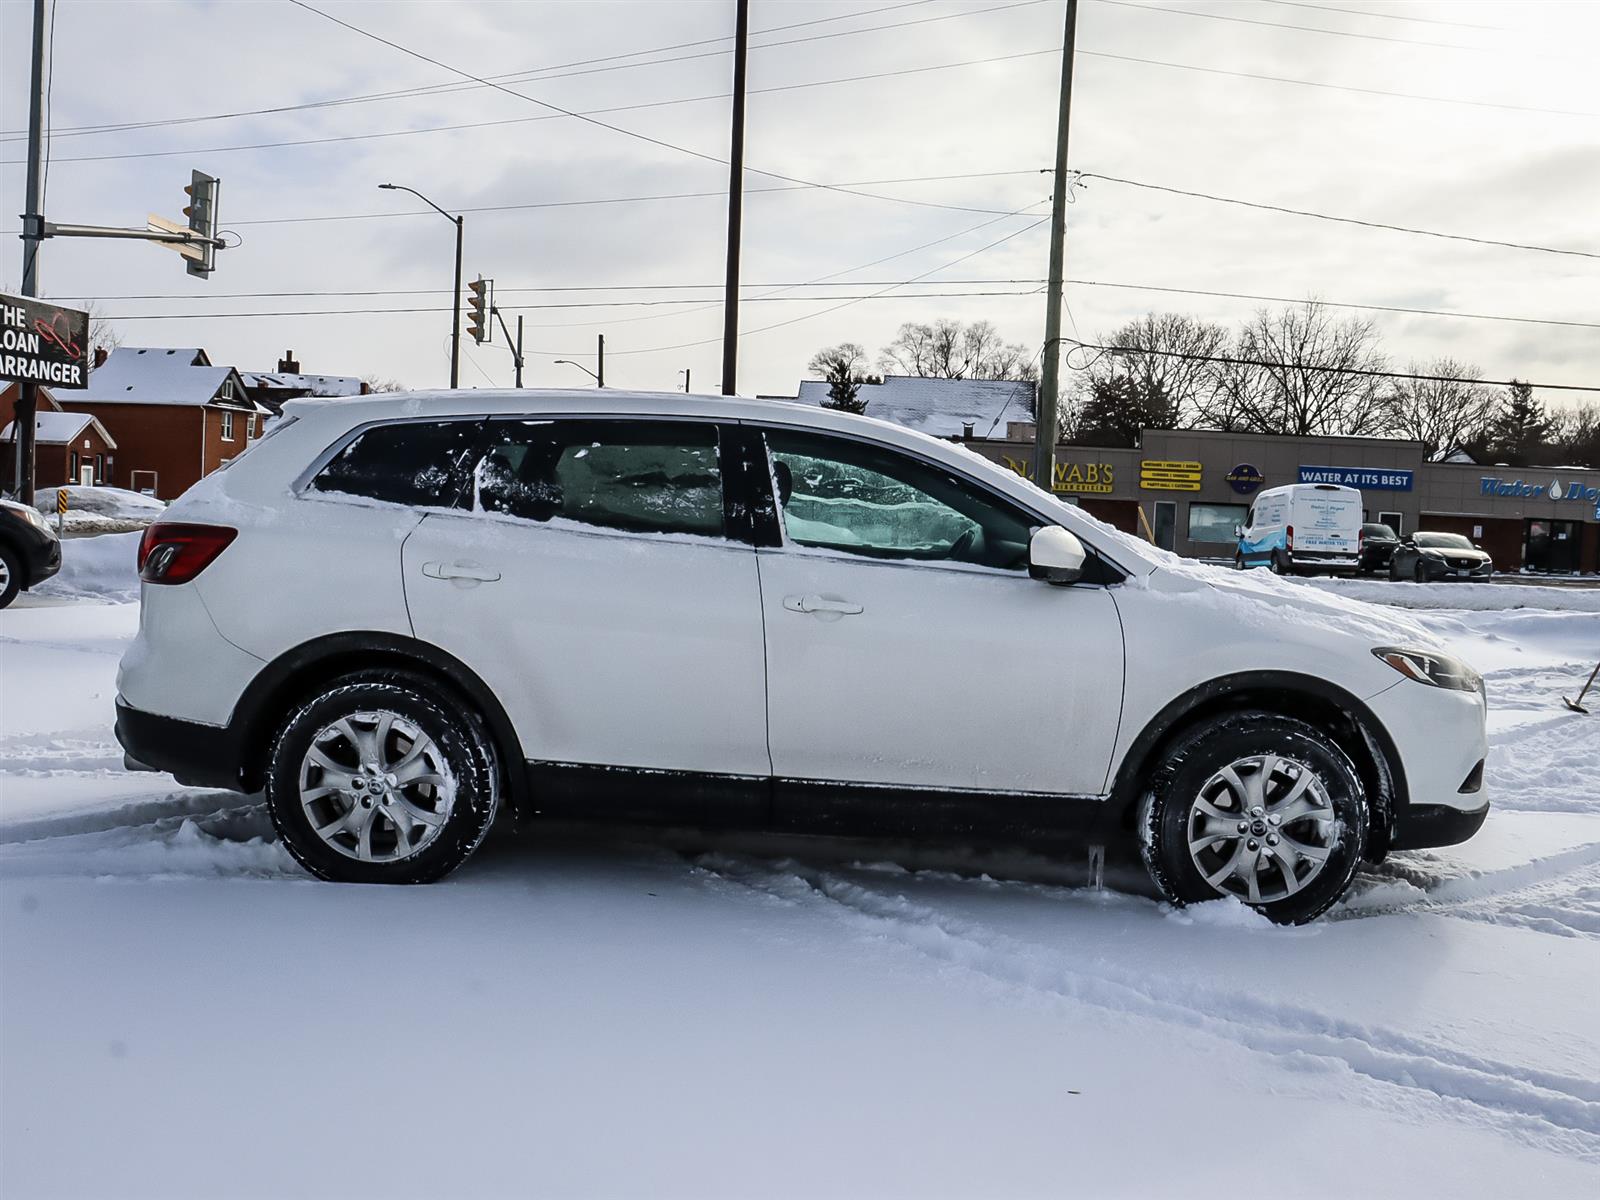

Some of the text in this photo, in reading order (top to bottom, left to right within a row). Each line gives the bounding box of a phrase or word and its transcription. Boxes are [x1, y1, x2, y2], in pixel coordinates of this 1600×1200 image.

[0, 329, 39, 354] OAN
[1001, 455, 1113, 483] NWAB'S
[1301, 472, 1408, 486] WATER AT ITS BEST
[1480, 477, 1544, 497] Water
